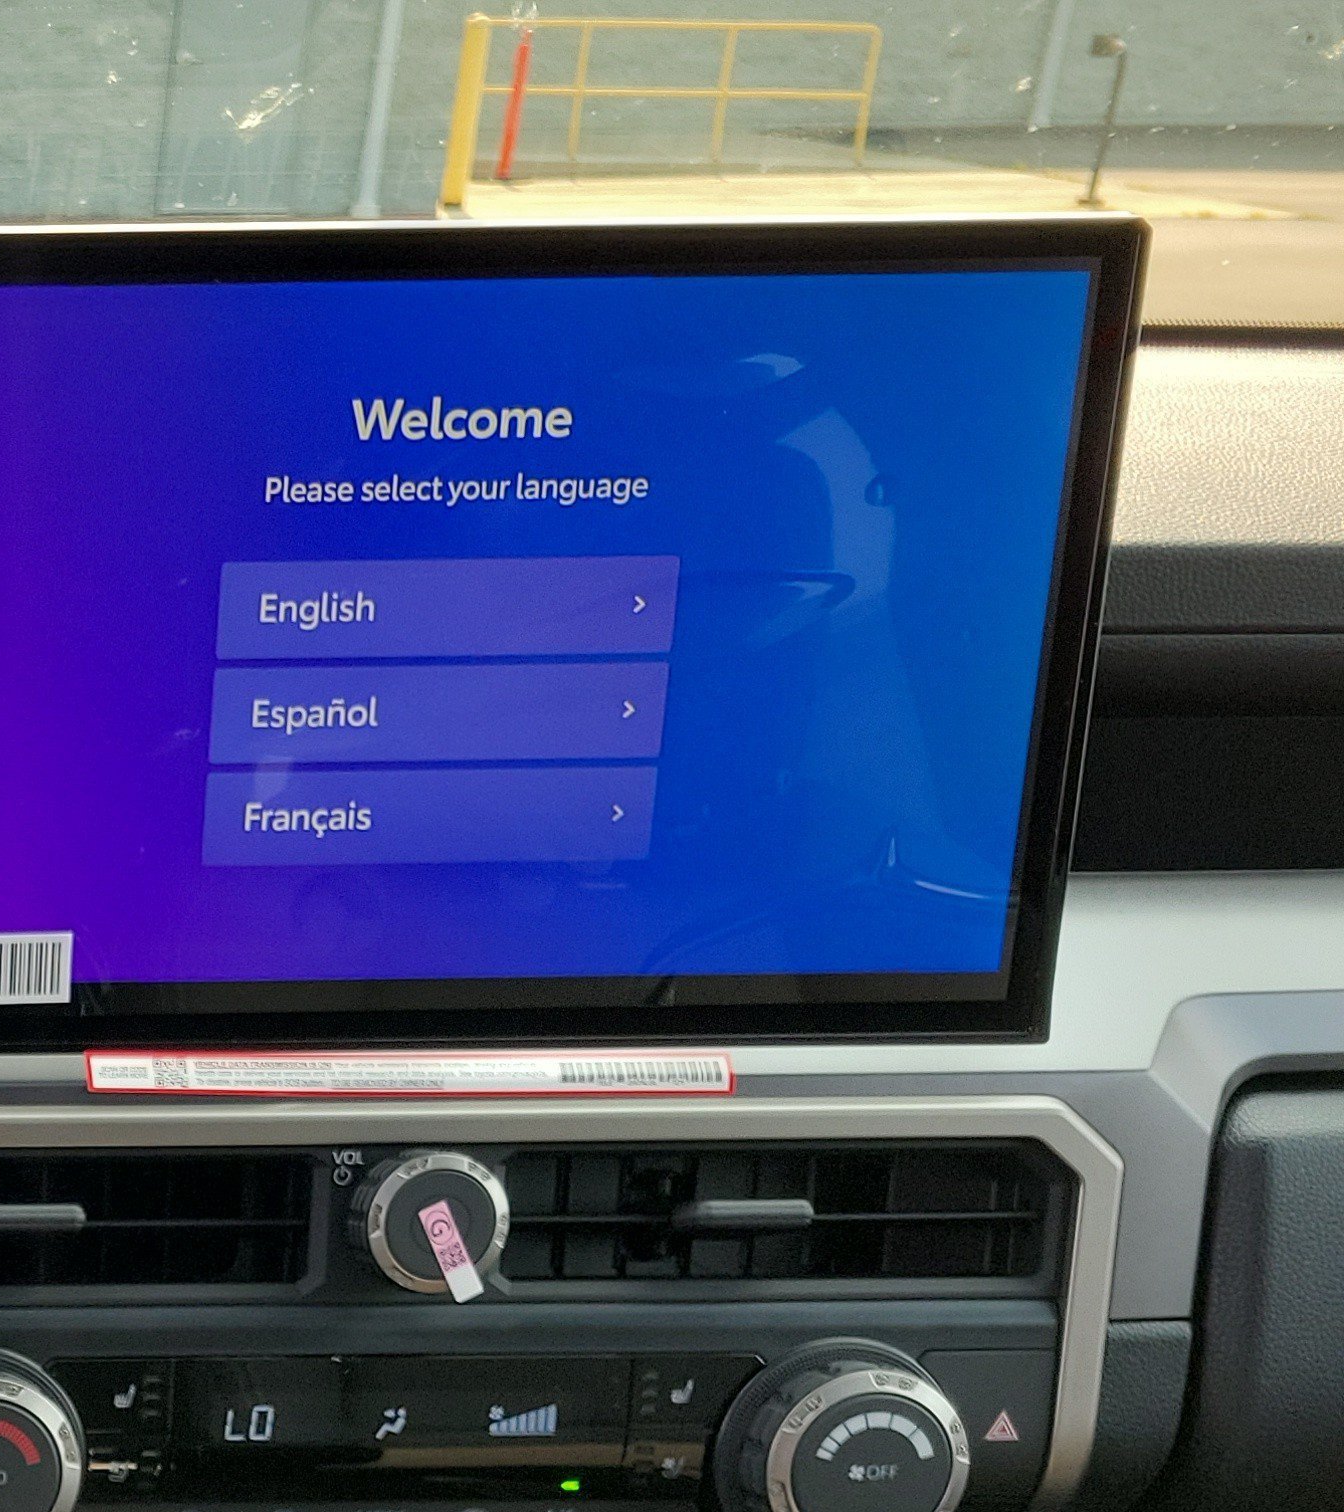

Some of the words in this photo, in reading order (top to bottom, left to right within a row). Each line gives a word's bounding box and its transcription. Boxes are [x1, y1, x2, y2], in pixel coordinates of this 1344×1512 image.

[351, 396, 574, 441] Welcome
[264, 476, 355, 503] Please
[360, 474, 443, 502] select
[445, 478, 510, 506] your
[516, 473, 649, 505] language
[259, 592, 376, 631] English
[251, 697, 378, 735] Español
[243, 801, 372, 838] Français
[332, 1151, 364, 1166] VOL
[224, 1404, 275, 1442] LO
[867, 1463, 899, 1483] OFF
